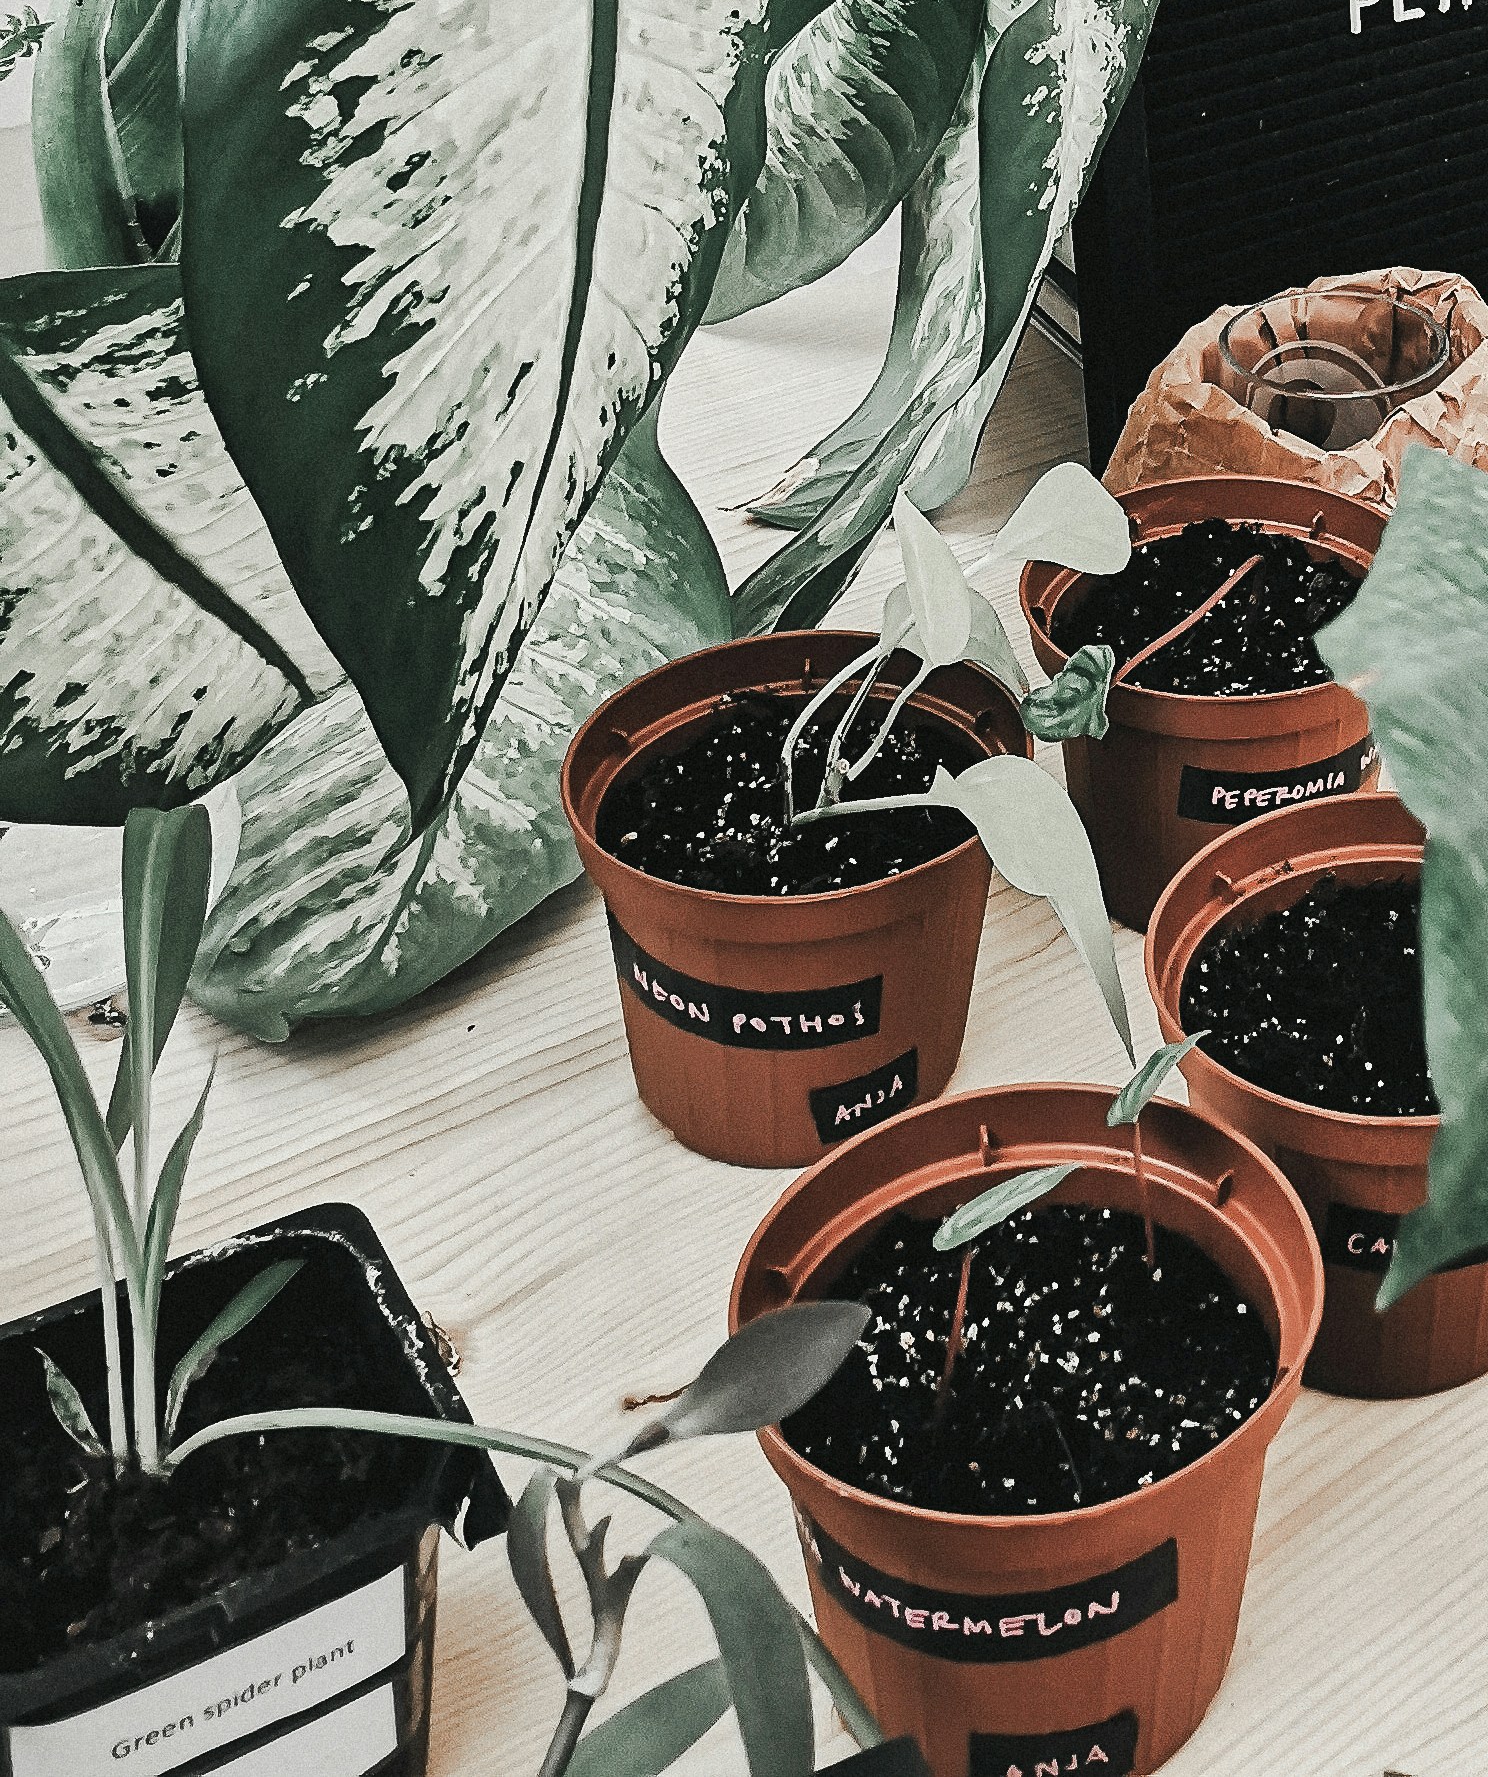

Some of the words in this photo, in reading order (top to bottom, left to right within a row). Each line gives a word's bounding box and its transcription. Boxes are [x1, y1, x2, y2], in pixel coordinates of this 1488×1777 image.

[1212, 772, 1345, 809] PEPEROMIA
[633, 963, 709, 1022] NEON
[733, 1000, 864, 1034] POTHOS
[835, 1075, 903, 1125] ANJA
[839, 1566, 1120, 1638] WATERMELON
[111, 1715, 194, 1759] Green
[203, 1672, 282, 1722] spider
[291, 1639, 354, 1684] plant
